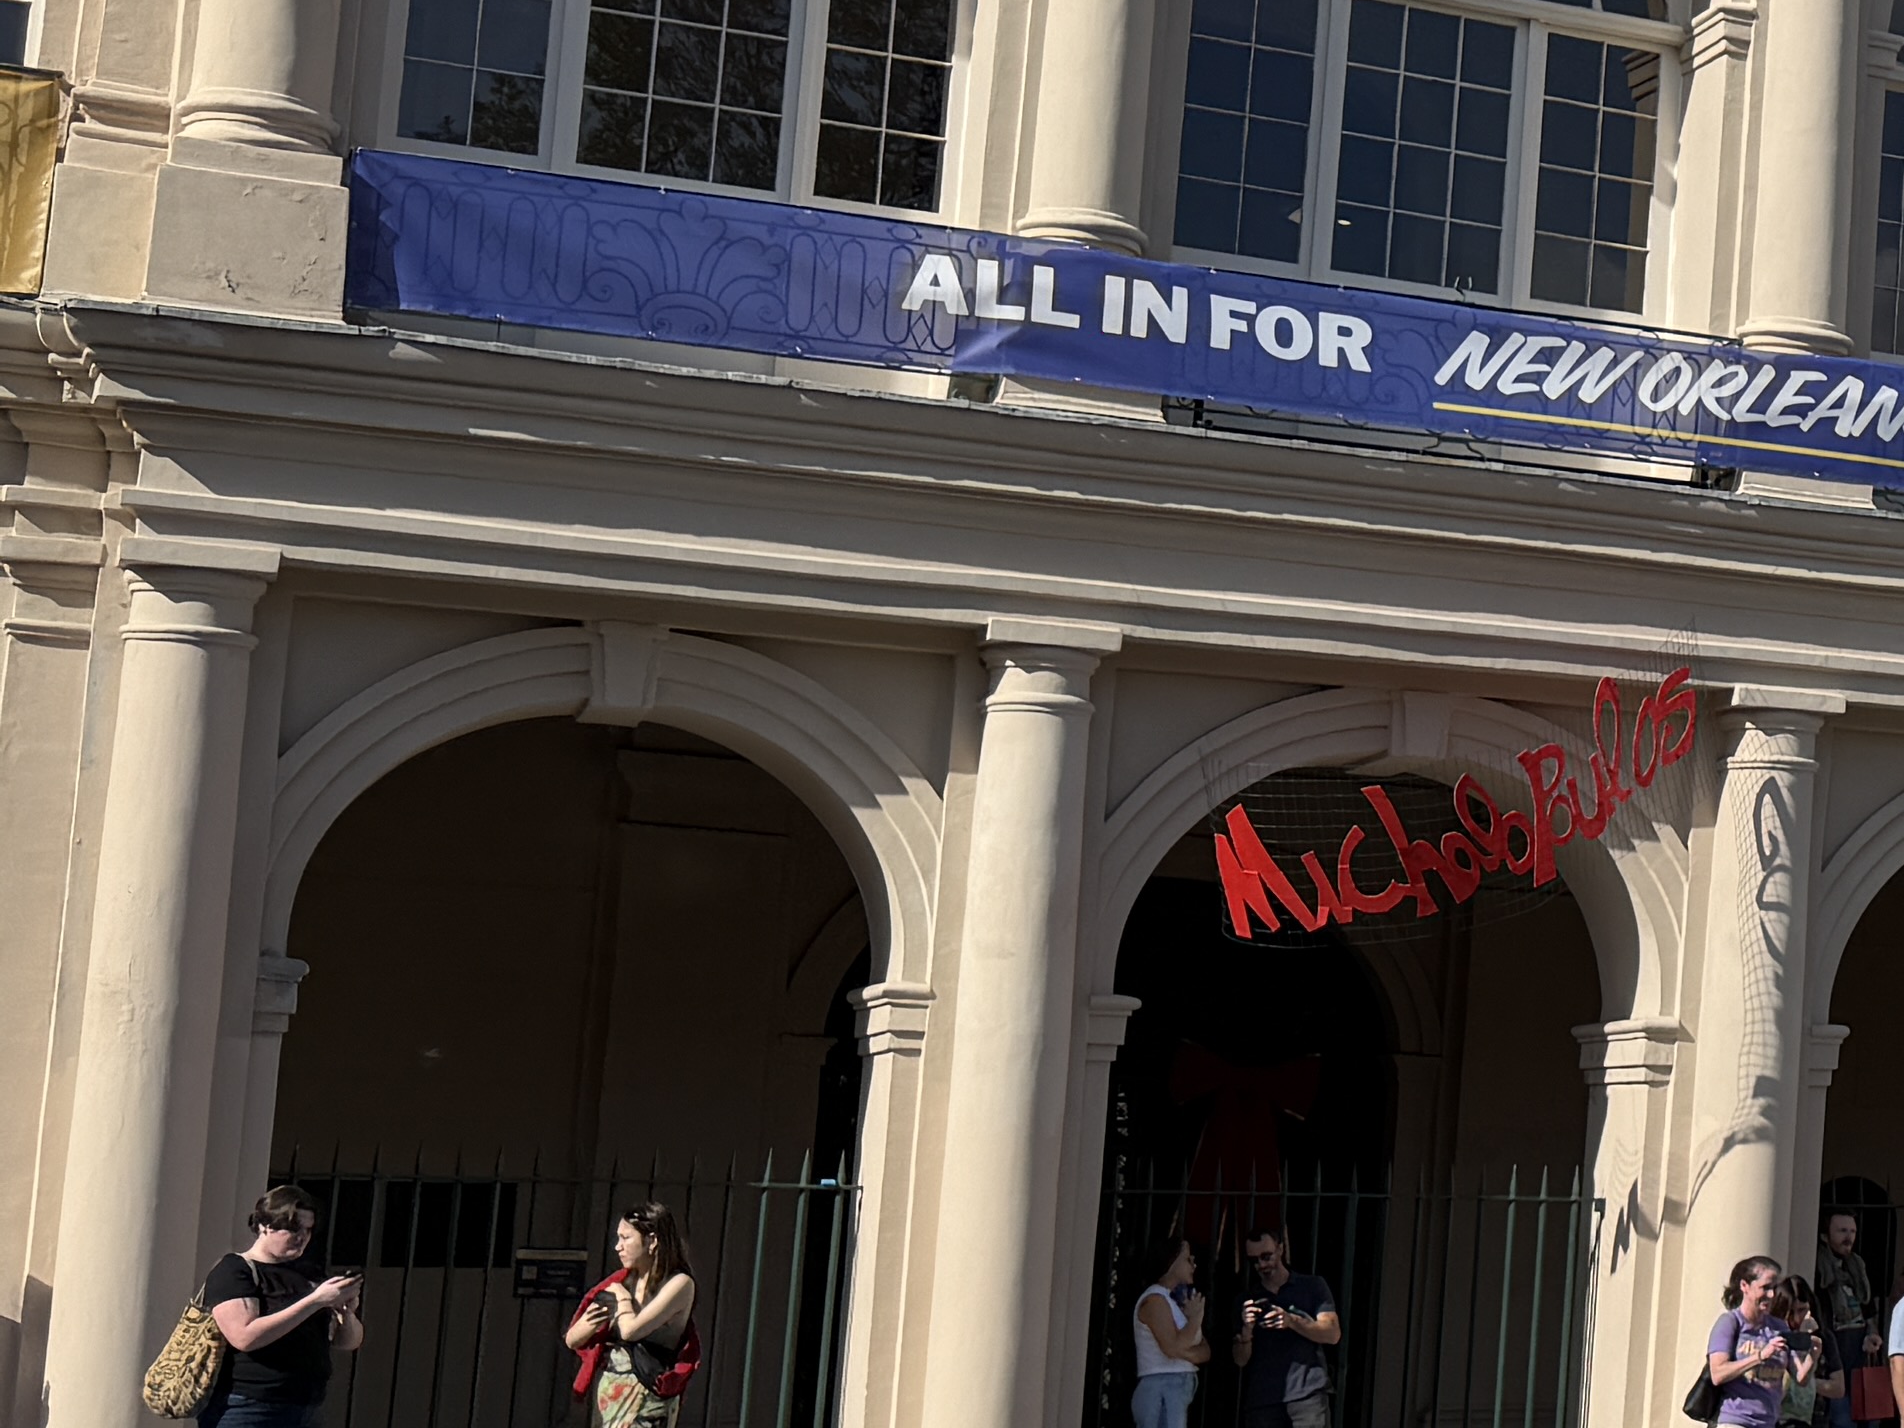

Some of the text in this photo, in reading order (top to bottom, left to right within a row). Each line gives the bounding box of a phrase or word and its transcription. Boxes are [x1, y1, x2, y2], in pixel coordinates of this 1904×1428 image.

[901, 253, 1081, 329] ALL
[1102, 274, 1189, 344] IN
[1209, 294, 1373, 373] FOR
[1433, 330, 1645, 404] NEW
